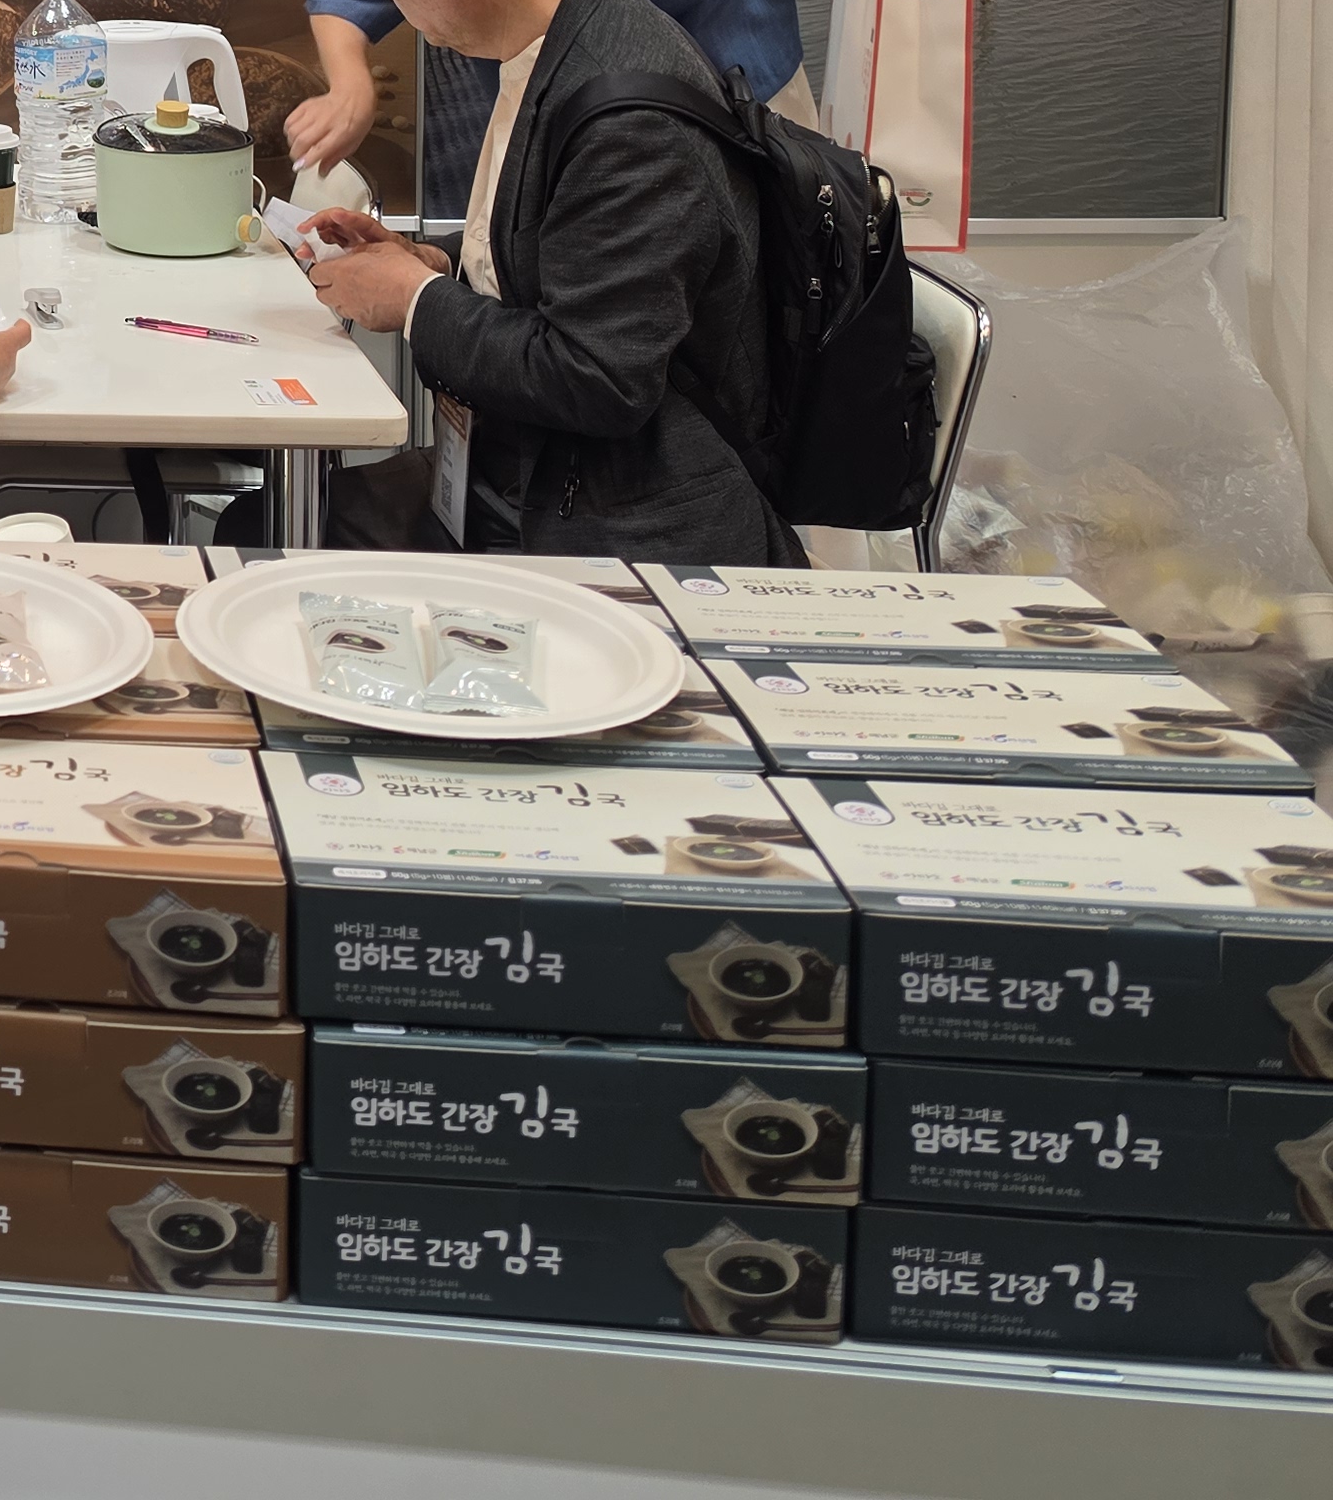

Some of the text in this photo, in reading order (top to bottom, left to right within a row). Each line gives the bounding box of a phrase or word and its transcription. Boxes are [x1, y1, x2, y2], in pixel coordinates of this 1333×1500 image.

[382, 782, 471, 801] 임하도
[480, 786, 538, 804] 간장
[335, 923, 420, 940] 바다김 그대로
[335, 942, 417, 971] 임하도
[425, 947, 482, 979] 간장
[901, 952, 994, 971] 바다김 그대로
[901, 972, 990, 1003] 임하도
[999, 979, 1062, 1011] 간장
[351, 1077, 436, 1095] 바다김 그대로
[351, 1097, 433, 1126] 임하도
[441, 1102, 498, 1134] 간장
[912, 1103, 1005, 1123] 바다김 그대로
[912, 1123, 1001, 1155] 임하도
[1010, 1129, 1072, 1163] 간장
[336, 1215, 421, 1232] 바다김 그대로
[336, 1233, 418, 1262] 임하도
[425, 1238, 481, 1269] 간장
[892, 1246, 984, 1266] 바다김 그대로
[893, 1265, 979, 1296] 임하도
[989, 1272, 1050, 1305] 간장
